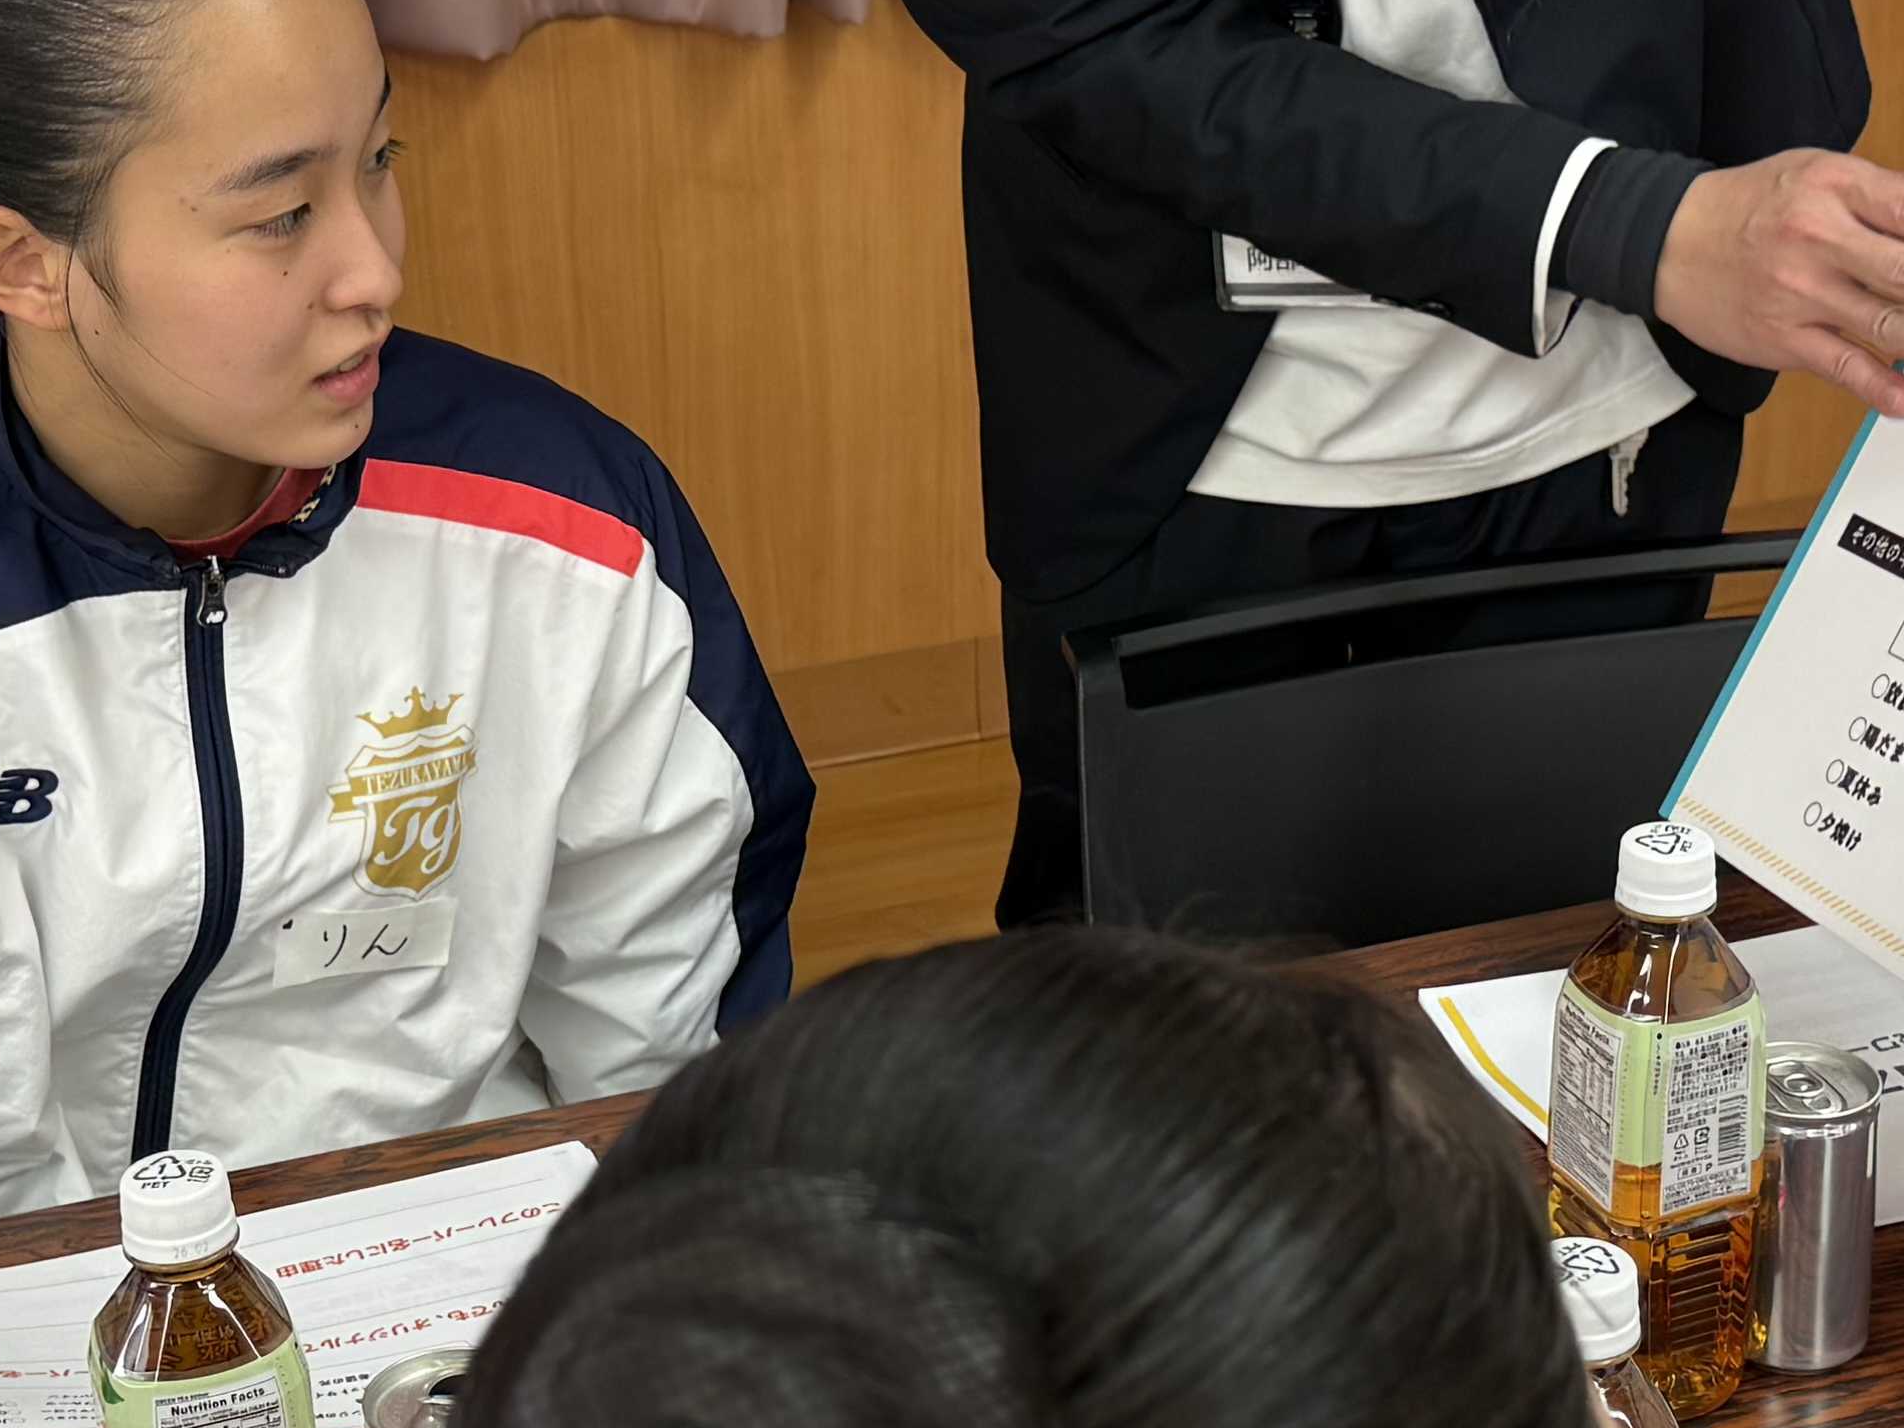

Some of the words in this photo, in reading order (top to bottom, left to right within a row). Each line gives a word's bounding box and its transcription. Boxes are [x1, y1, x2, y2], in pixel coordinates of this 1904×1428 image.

[1838, 766, 1883, 807] 夏休み
[1815, 809, 1863, 853] 夕焼け
[276, 1202, 560, 1278] このフレーバー名にした理由
[170, 1398, 228, 1417] Nutrition
[231, 1387, 265, 1404] Facts
